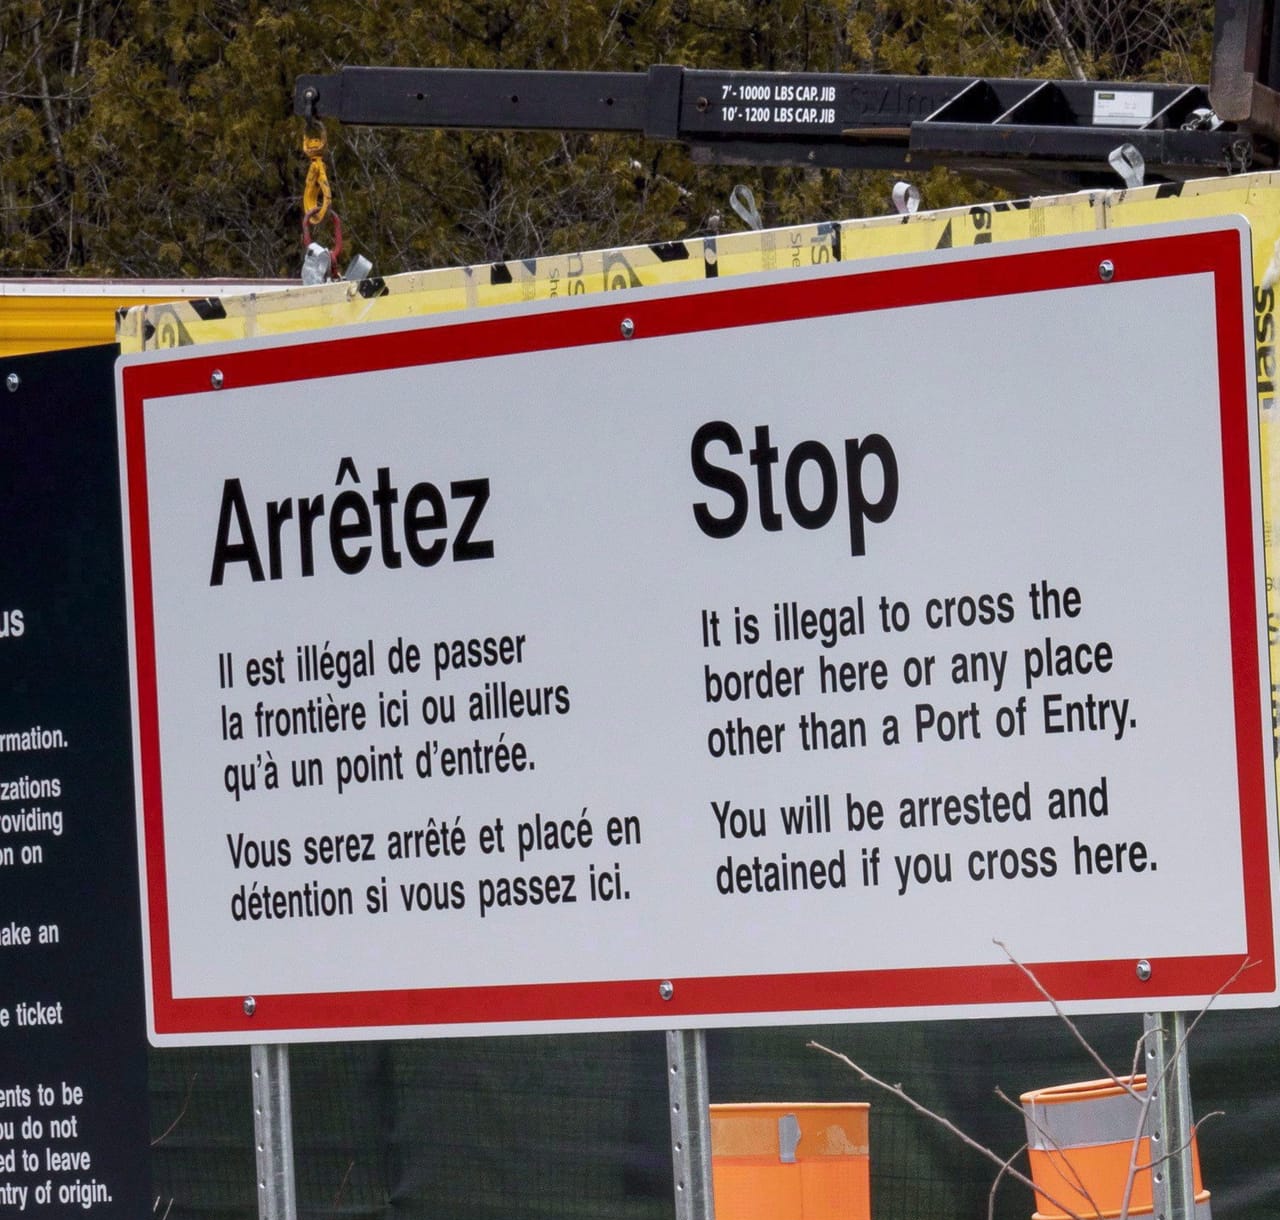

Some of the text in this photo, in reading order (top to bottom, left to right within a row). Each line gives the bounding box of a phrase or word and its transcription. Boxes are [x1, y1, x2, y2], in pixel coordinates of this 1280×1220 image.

[739, 86, 771, 100] 10000
[774, 86, 794, 100] LBS
[795, 86, 819, 101] CAP.
[820, 87, 836, 102] JIB
[745, 107, 770, 122] 1200
[774, 108, 794, 122] LBS
[795, 108, 818, 123] CAP.
[819, 109, 835, 123] JIB
[690, 420, 899, 557] Stop
[209, 456, 495, 587] Arrêtez
[701, 579, 1082, 649] It is illegal to cross the
[218, 634, 526, 689] Il est illégal de passer
[704, 636, 1113, 703] border here or any place
[221, 681, 571, 741] la frontière ici ou ailleurs
[707, 693, 1137, 758] other than a Port of Entry.
[224, 732, 535, 802] qu'à un point d'entrée.
[710, 776, 1109, 839] You will be arrested and
[20, 844, 43, 865] on
[226, 807, 641, 869] Vous serez arrêté et placé en
[716, 835, 1157, 896] detained if you cross here.
[231, 862, 631, 922] détention si vous passez ici.
[38, 924, 60, 945] an
[15, 1001, 64, 1027] ticket
[37, 1083, 55, 1107] to
[61, 1081, 84, 1106] be
[21, 1115, 43, 1140] do
[50, 1115, 78, 1139] not
[21, 1149, 40, 1172] to
[46, 1147, 91, 1172] leave
[34, 1179, 52, 1205] of
[58, 1178, 113, 1210] origin.
